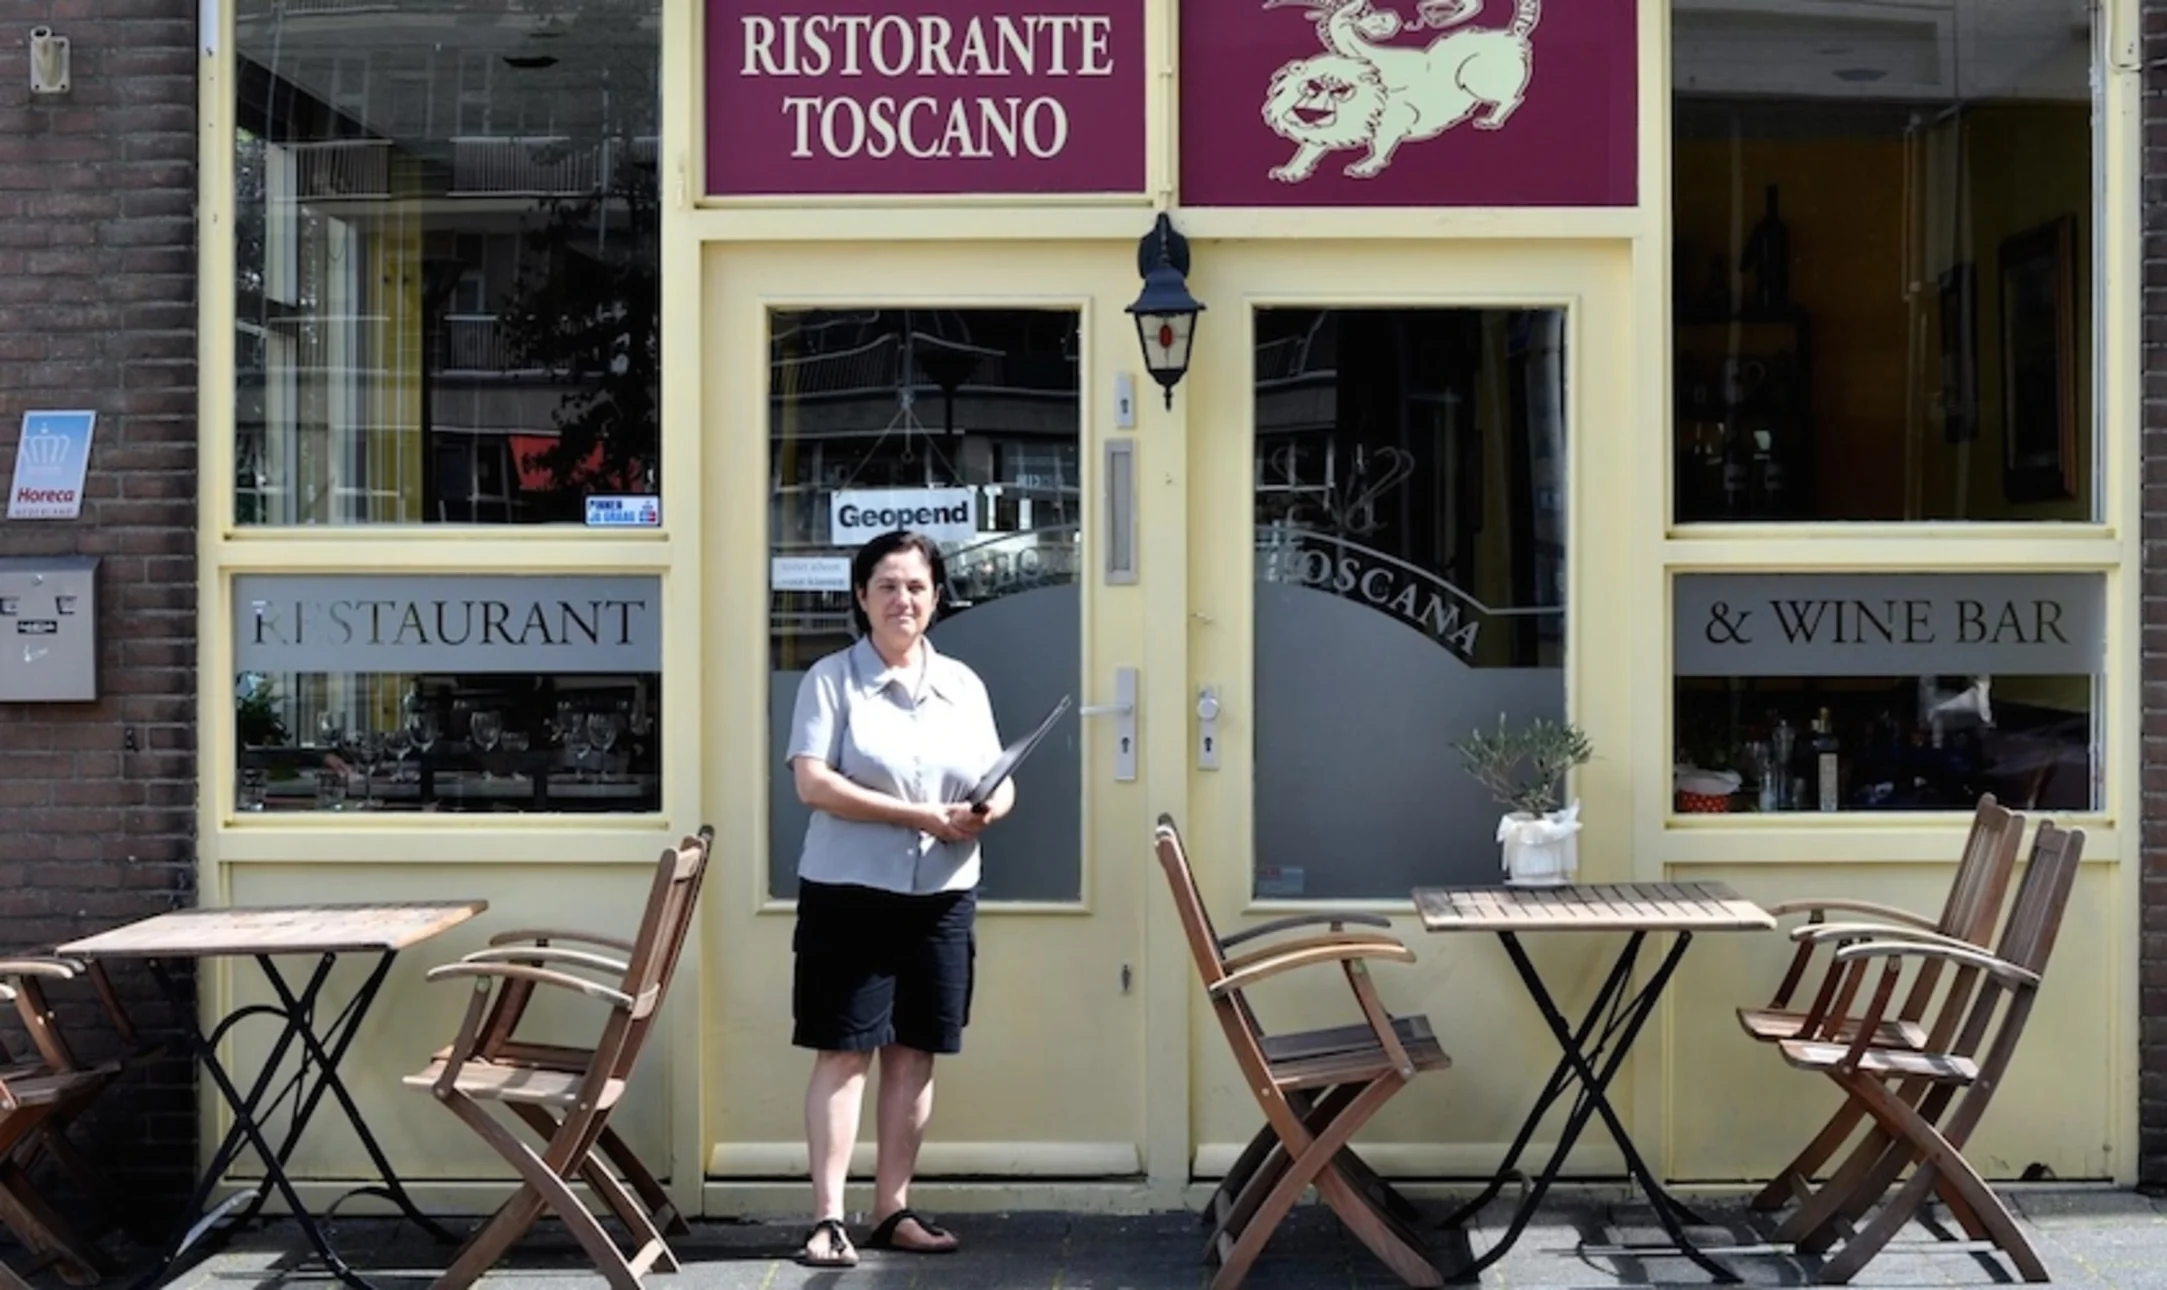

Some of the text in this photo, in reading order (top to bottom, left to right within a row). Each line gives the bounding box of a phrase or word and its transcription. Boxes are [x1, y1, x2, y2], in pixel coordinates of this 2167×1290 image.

[740, 15, 1114, 76] RISTORANTE
[782, 97, 1069, 159] TOSCANO
[17, 487, 75, 503] Horeca
[838, 500, 969, 532] Geopend
[250, 600, 646, 646] RESTAURANT
[1272, 546, 1481, 656] OSCANA
[1705, 600, 2071, 645] & WINE BAR
